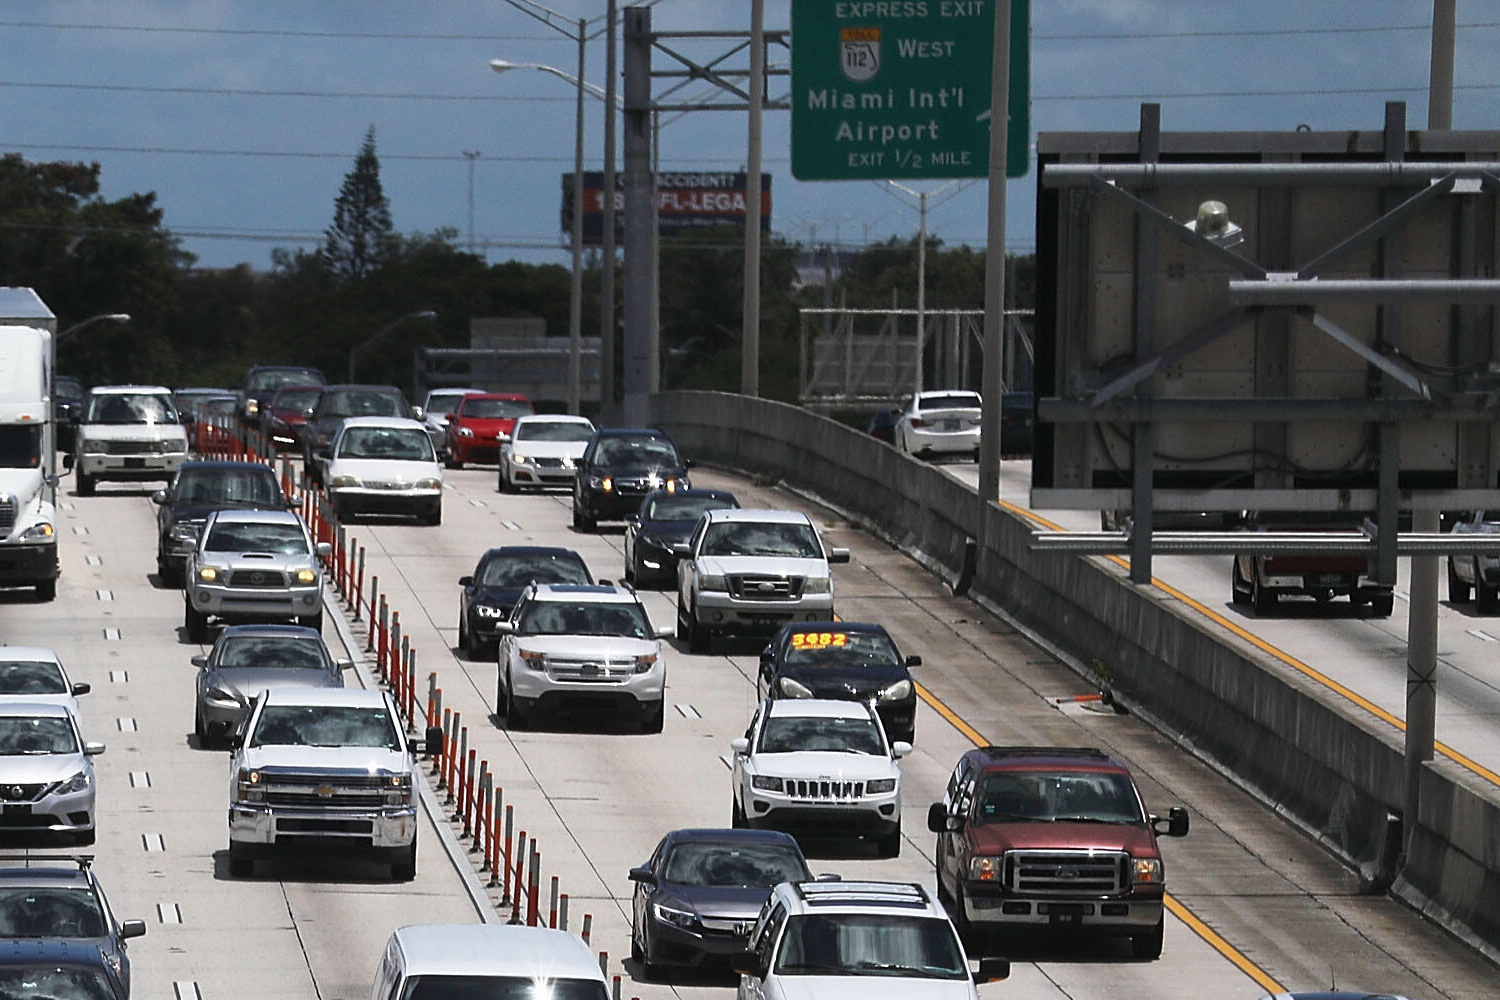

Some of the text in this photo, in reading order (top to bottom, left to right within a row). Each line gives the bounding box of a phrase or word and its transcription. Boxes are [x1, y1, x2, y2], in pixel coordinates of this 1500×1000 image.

[835, 1, 985, 18] EXPRESS EXIT
[898, 38, 955, 59] WEST
[847, 51, 868, 67] 112
[808, 87, 964, 110] Miami Int'l
[835, 120, 939, 144] Airport
[848, 152, 884, 166] EXIT
[931, 151, 971, 165] MILE
